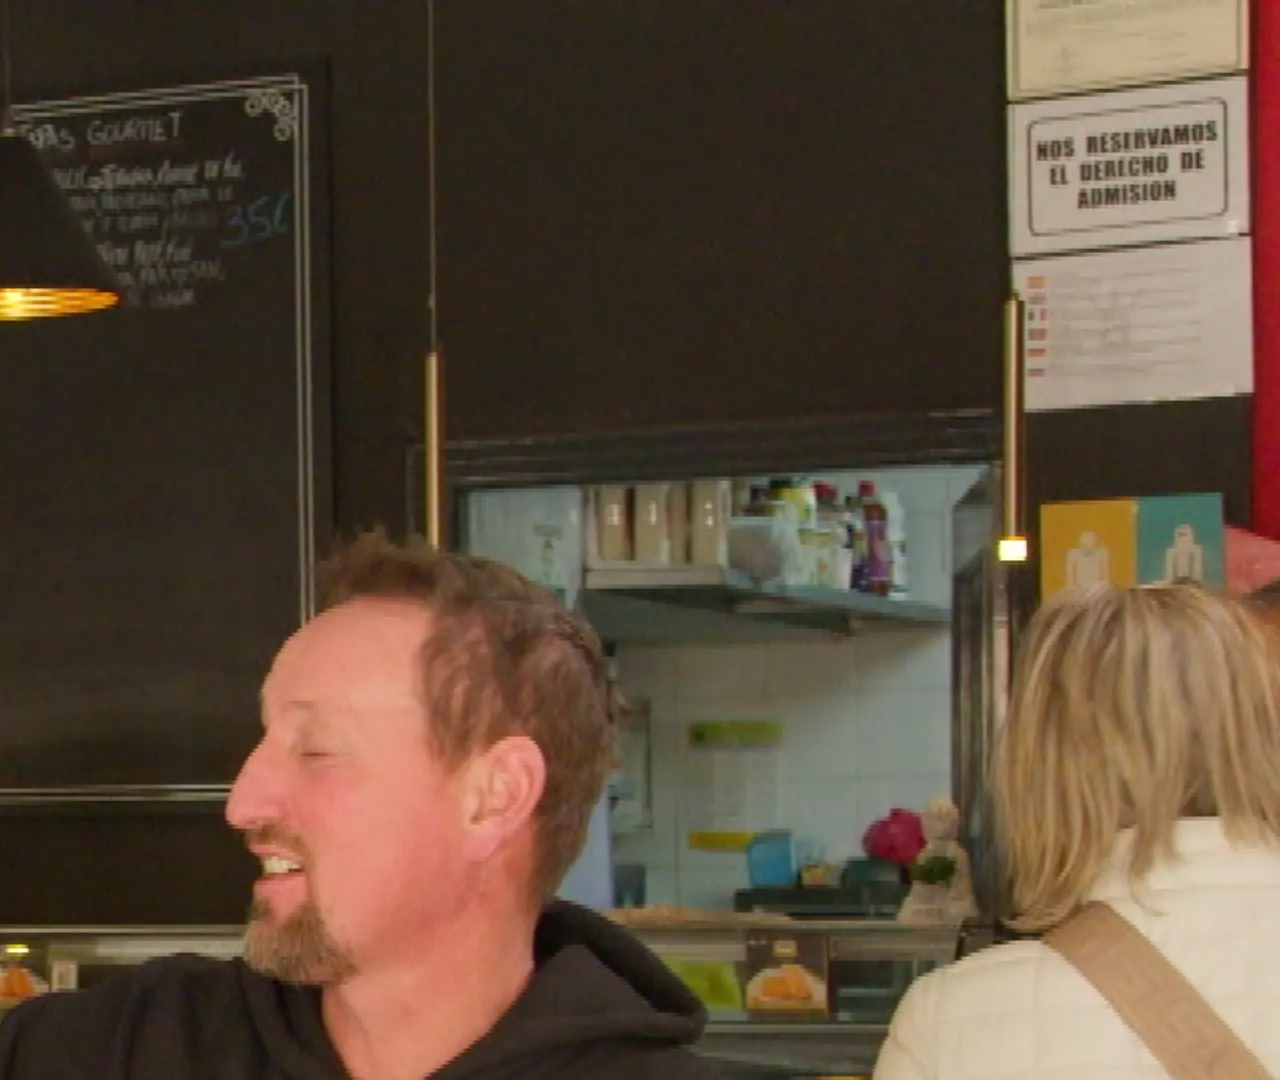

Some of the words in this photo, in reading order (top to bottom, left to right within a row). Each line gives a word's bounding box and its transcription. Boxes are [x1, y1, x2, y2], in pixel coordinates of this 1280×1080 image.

[1037, 137, 1075, 162] NOS
[1086, 120, 1218, 156] RESERVAMOS
[1049, 164, 1070, 187] EL
[1079, 152, 1170, 183] DERECHO
[1180, 148, 1205, 172] DE
[1077, 179, 1177, 210] ADMISION
